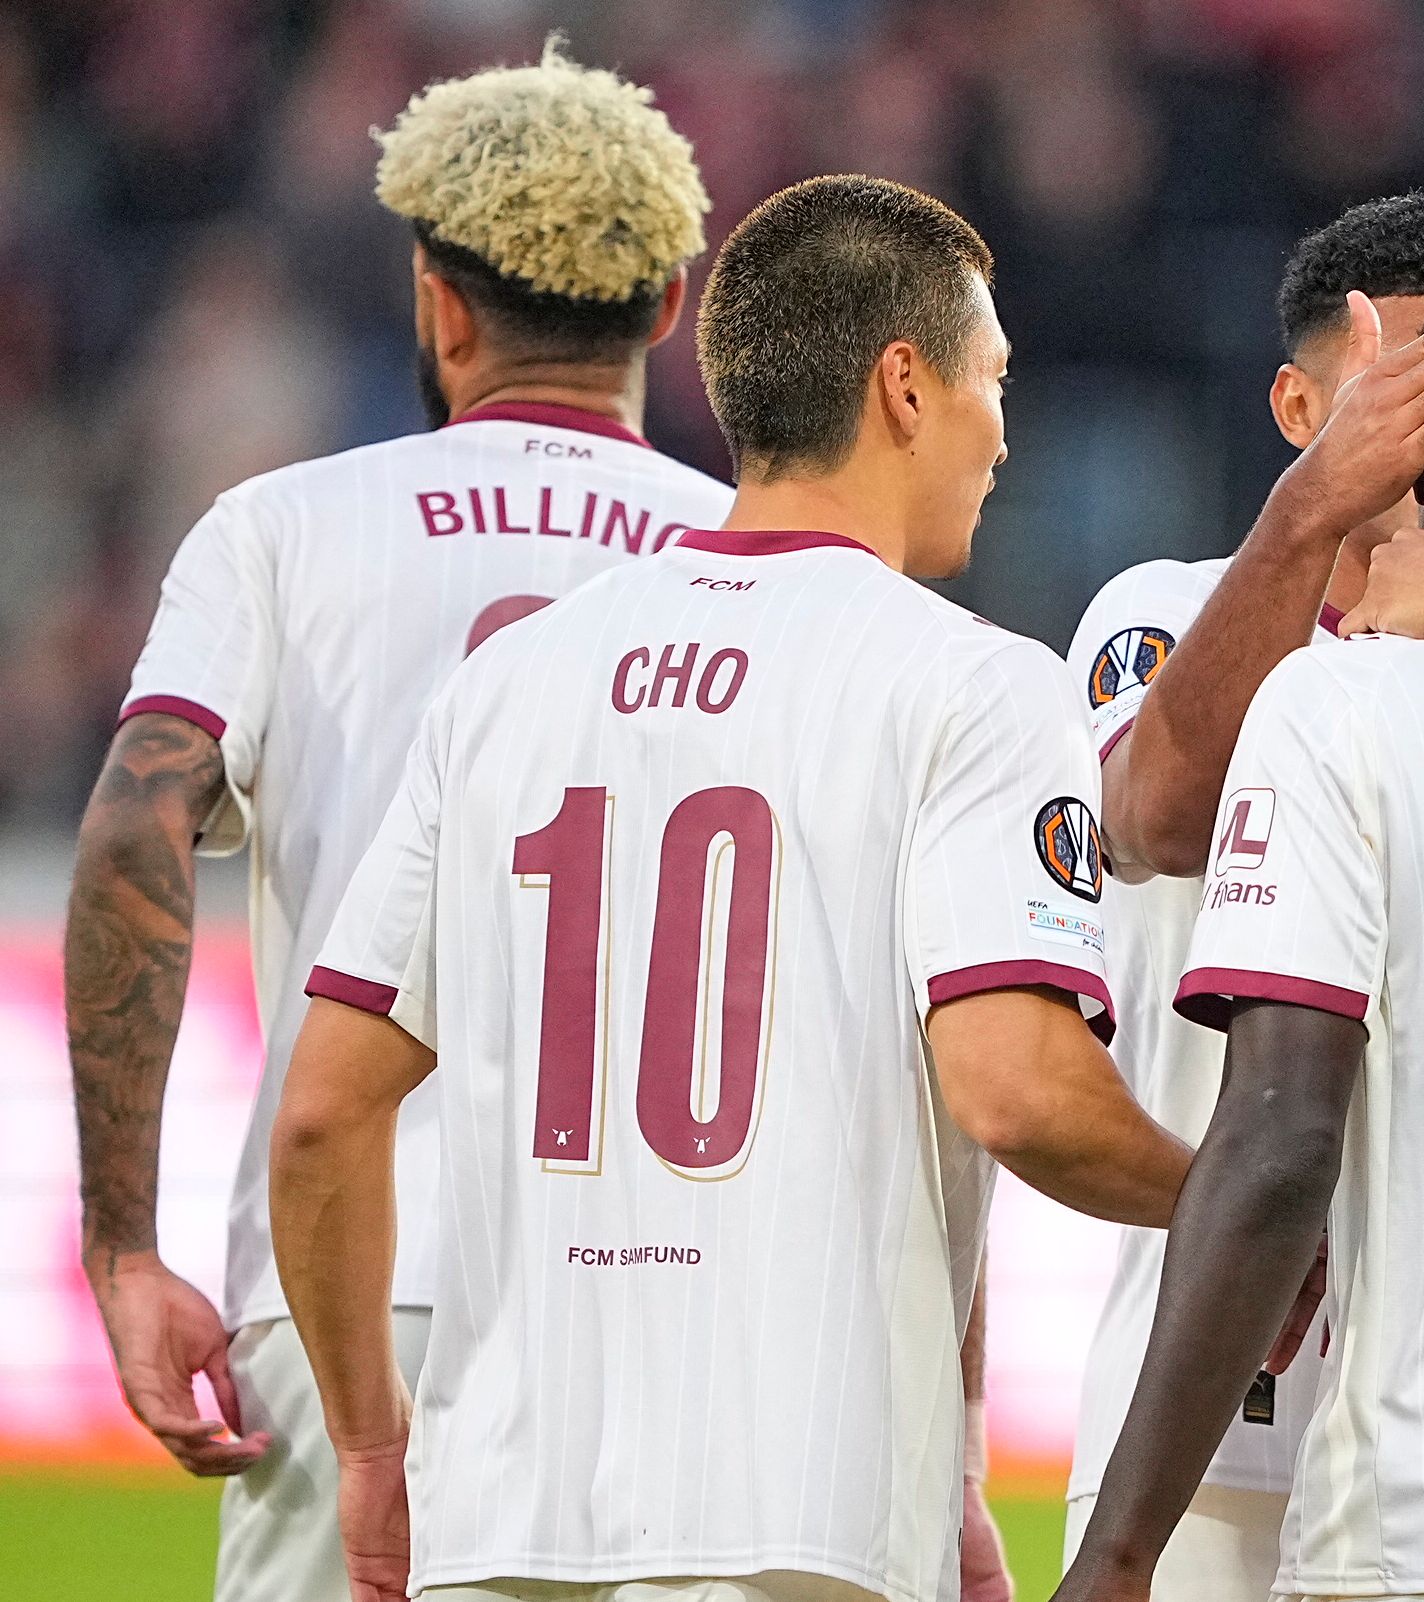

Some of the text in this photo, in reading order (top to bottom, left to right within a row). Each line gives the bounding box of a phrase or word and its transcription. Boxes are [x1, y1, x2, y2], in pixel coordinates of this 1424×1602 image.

[524, 439, 594, 460] FCM
[688, 577, 757, 592] FCM
[611, 642, 749, 715] CHO
[1027, 899, 1049, 910] UEFA
[511, 785, 783, 1183] 10
[567, 1245, 702, 1266] FCM SAMFUND
